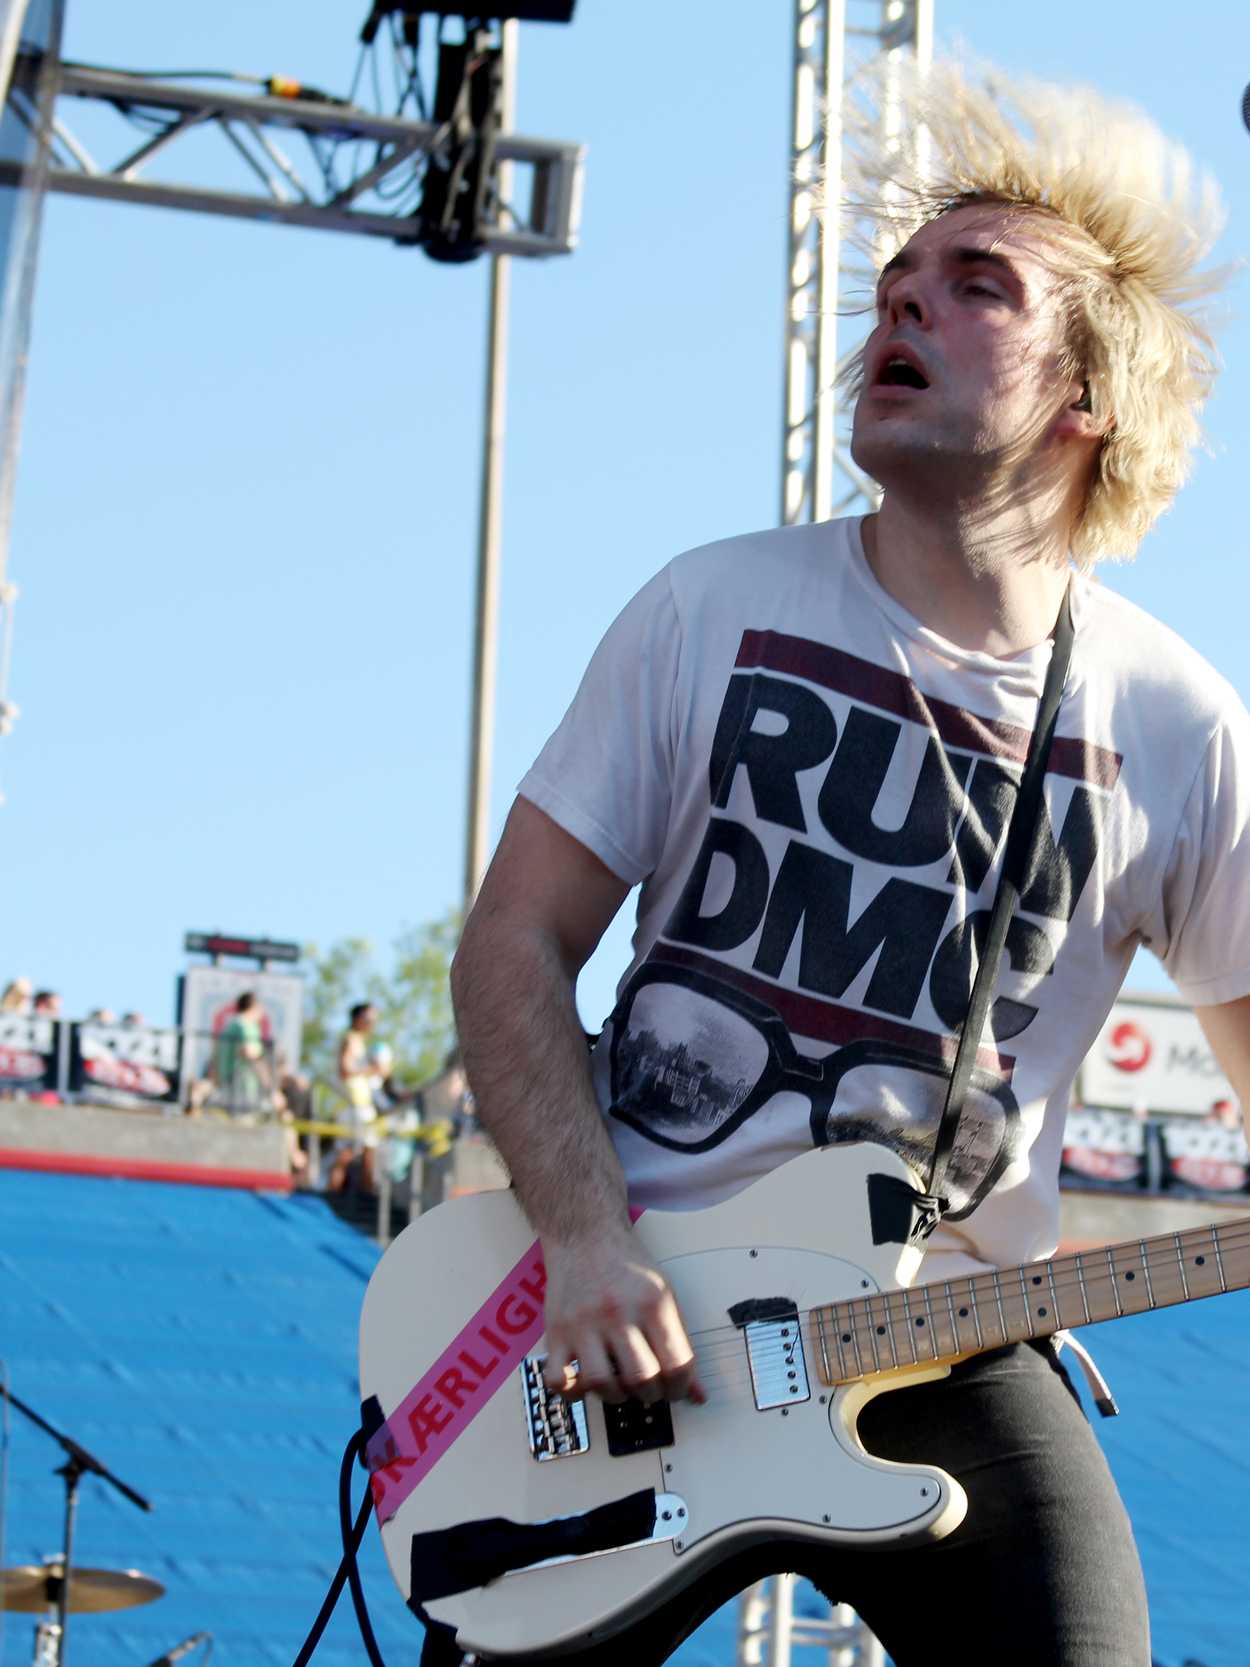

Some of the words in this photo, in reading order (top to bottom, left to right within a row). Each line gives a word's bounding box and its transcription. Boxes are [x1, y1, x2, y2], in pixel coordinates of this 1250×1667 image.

[709, 673, 1109, 921] RUN
[661, 817, 1054, 1042] DMC
[371, 1261, 547, 1504] KÆRLIGH
